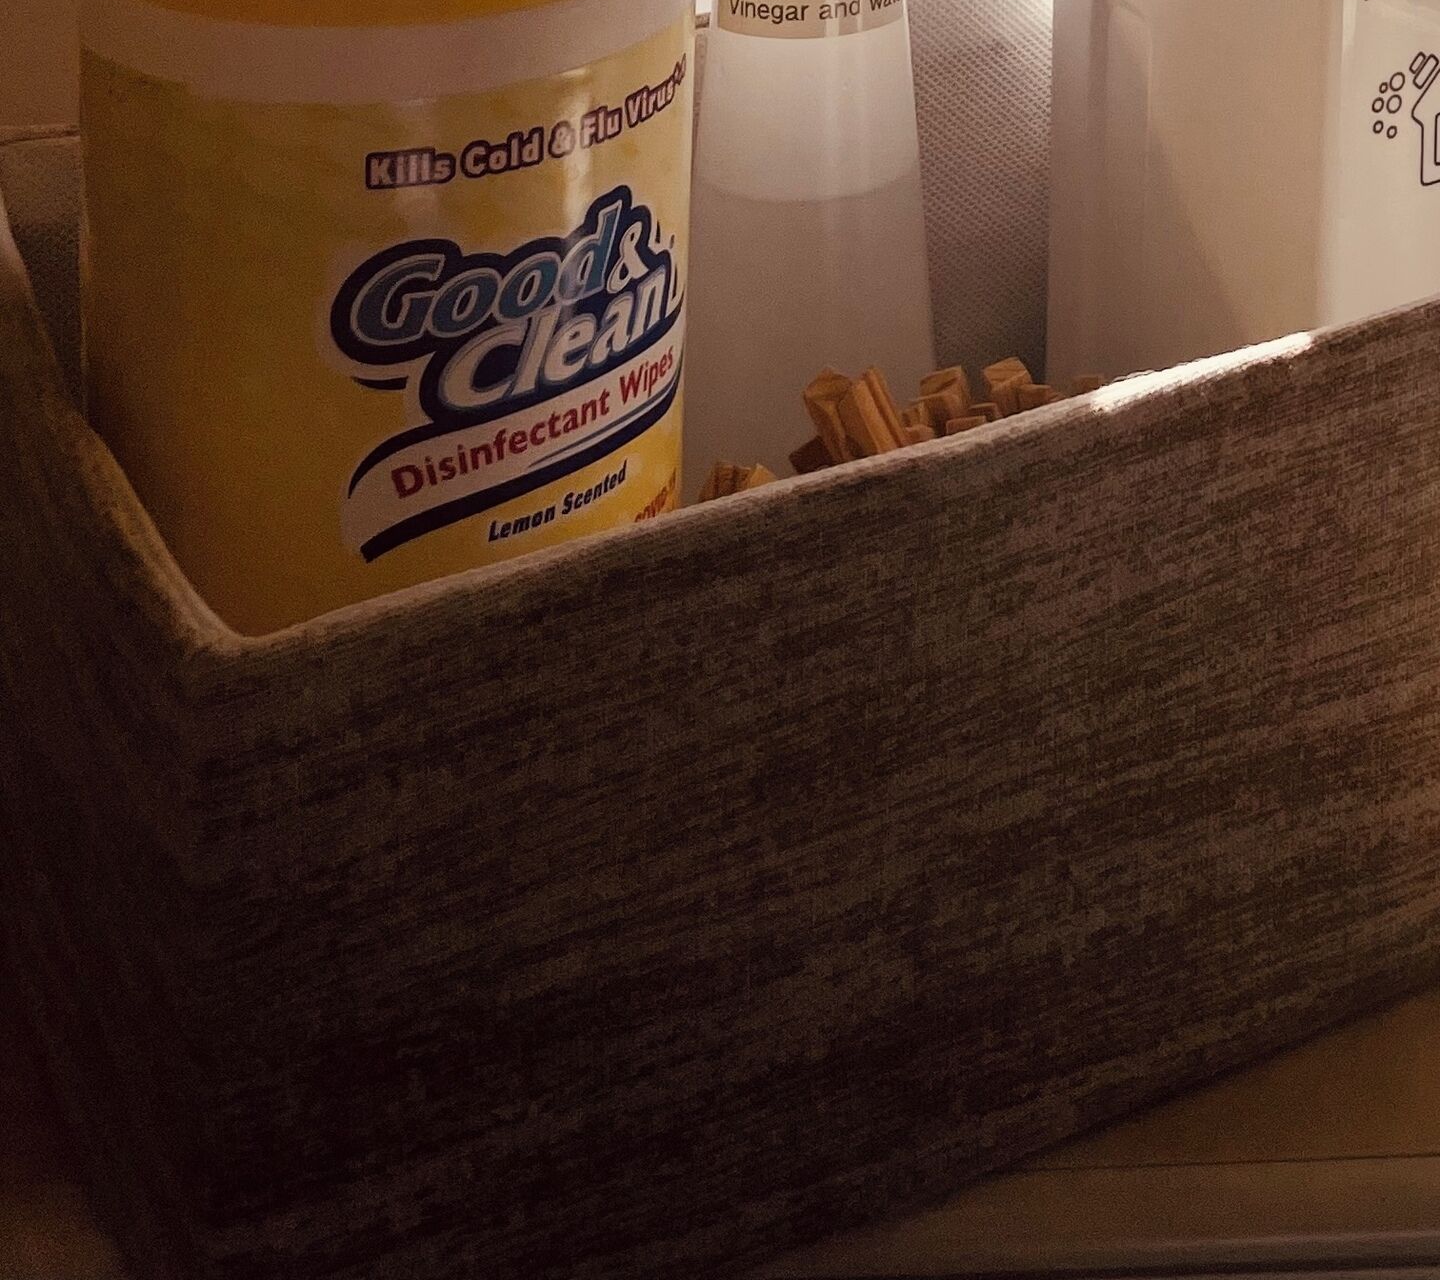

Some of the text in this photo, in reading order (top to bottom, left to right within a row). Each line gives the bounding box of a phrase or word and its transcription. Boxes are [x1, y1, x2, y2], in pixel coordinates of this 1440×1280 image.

[367, 147, 456, 188] Kills
[460, 127, 544, 177] Cold
[548, 121, 576, 157] &
[580, 106, 623, 148] Flu
[350, 199, 650, 345] Good &
[438, 264, 667, 411] Clean
[390, 387, 610, 499] Disinfectant
[618, 345, 675, 407] Wipes
[488, 503, 556, 542] Lemon
[561, 459, 628, 515] Scented
